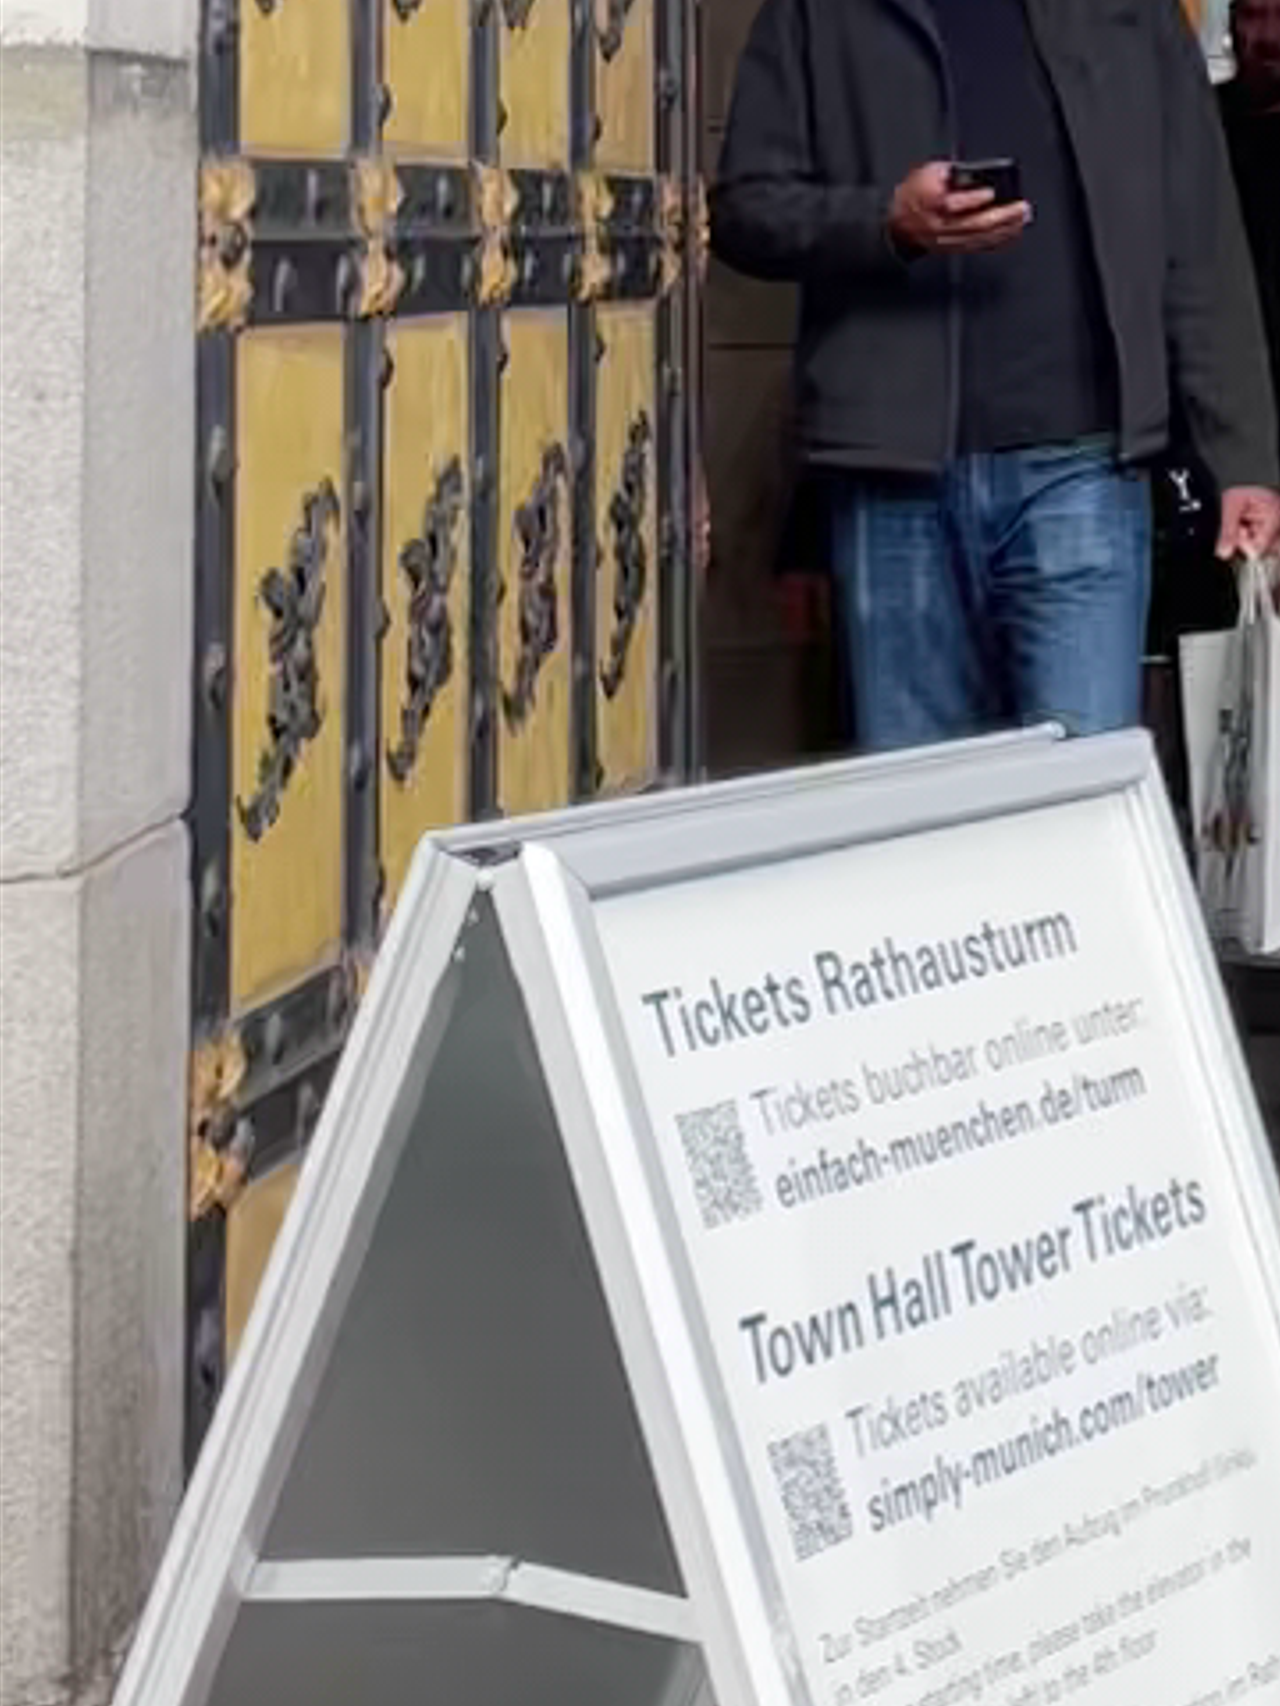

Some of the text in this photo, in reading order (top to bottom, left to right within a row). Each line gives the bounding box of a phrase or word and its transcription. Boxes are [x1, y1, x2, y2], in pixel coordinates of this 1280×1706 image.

[643, 909, 1080, 1059] Tickets Rathausturm
[752, 1073, 859, 1135] Tickets
[863, 1041, 980, 1103] buchbar
[986, 1012, 1071, 1070] online
[775, 1064, 1147, 1211] einfach-muenchen.de/turm
[740, 1179, 1206, 1384] Town Hall Tower Tickets
[846, 1392, 948, 1457] Tickets
[954, 1334, 1074, 1410] available
[1080, 1305, 1162, 1363] online
[869, 1351, 1221, 1533] simply-munich.com/tower
